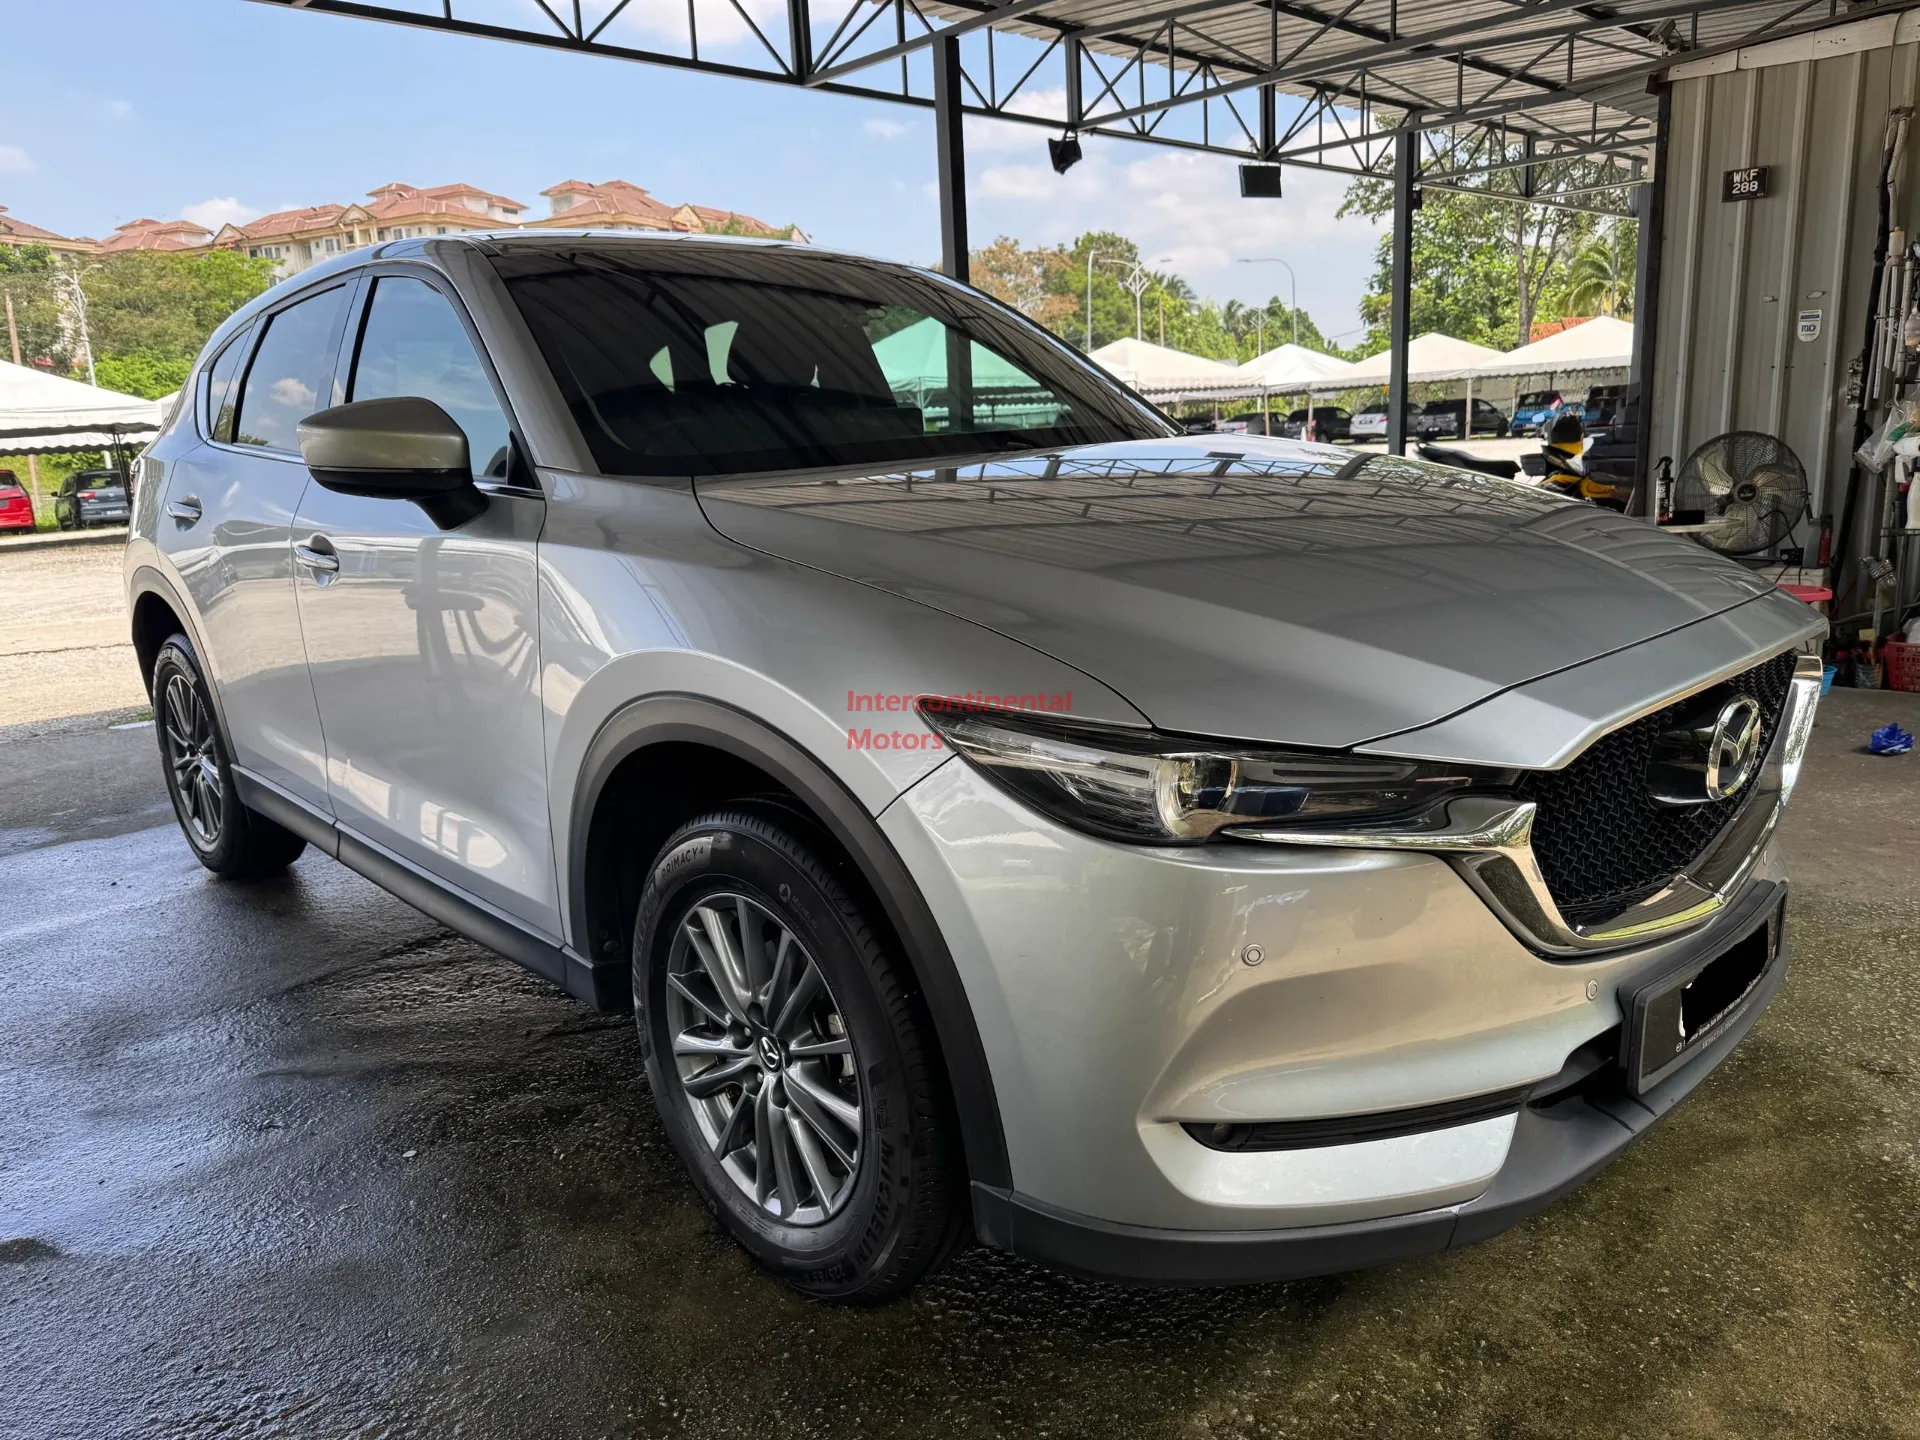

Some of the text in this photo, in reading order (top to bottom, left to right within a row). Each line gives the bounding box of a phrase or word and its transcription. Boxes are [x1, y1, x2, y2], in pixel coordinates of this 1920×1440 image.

[1733, 168, 1759, 183] WKF
[1731, 181, 1759, 194] 288
[661, 846, 698, 878] PRIMACY
[854, 1137, 896, 1266] MICHELIN
